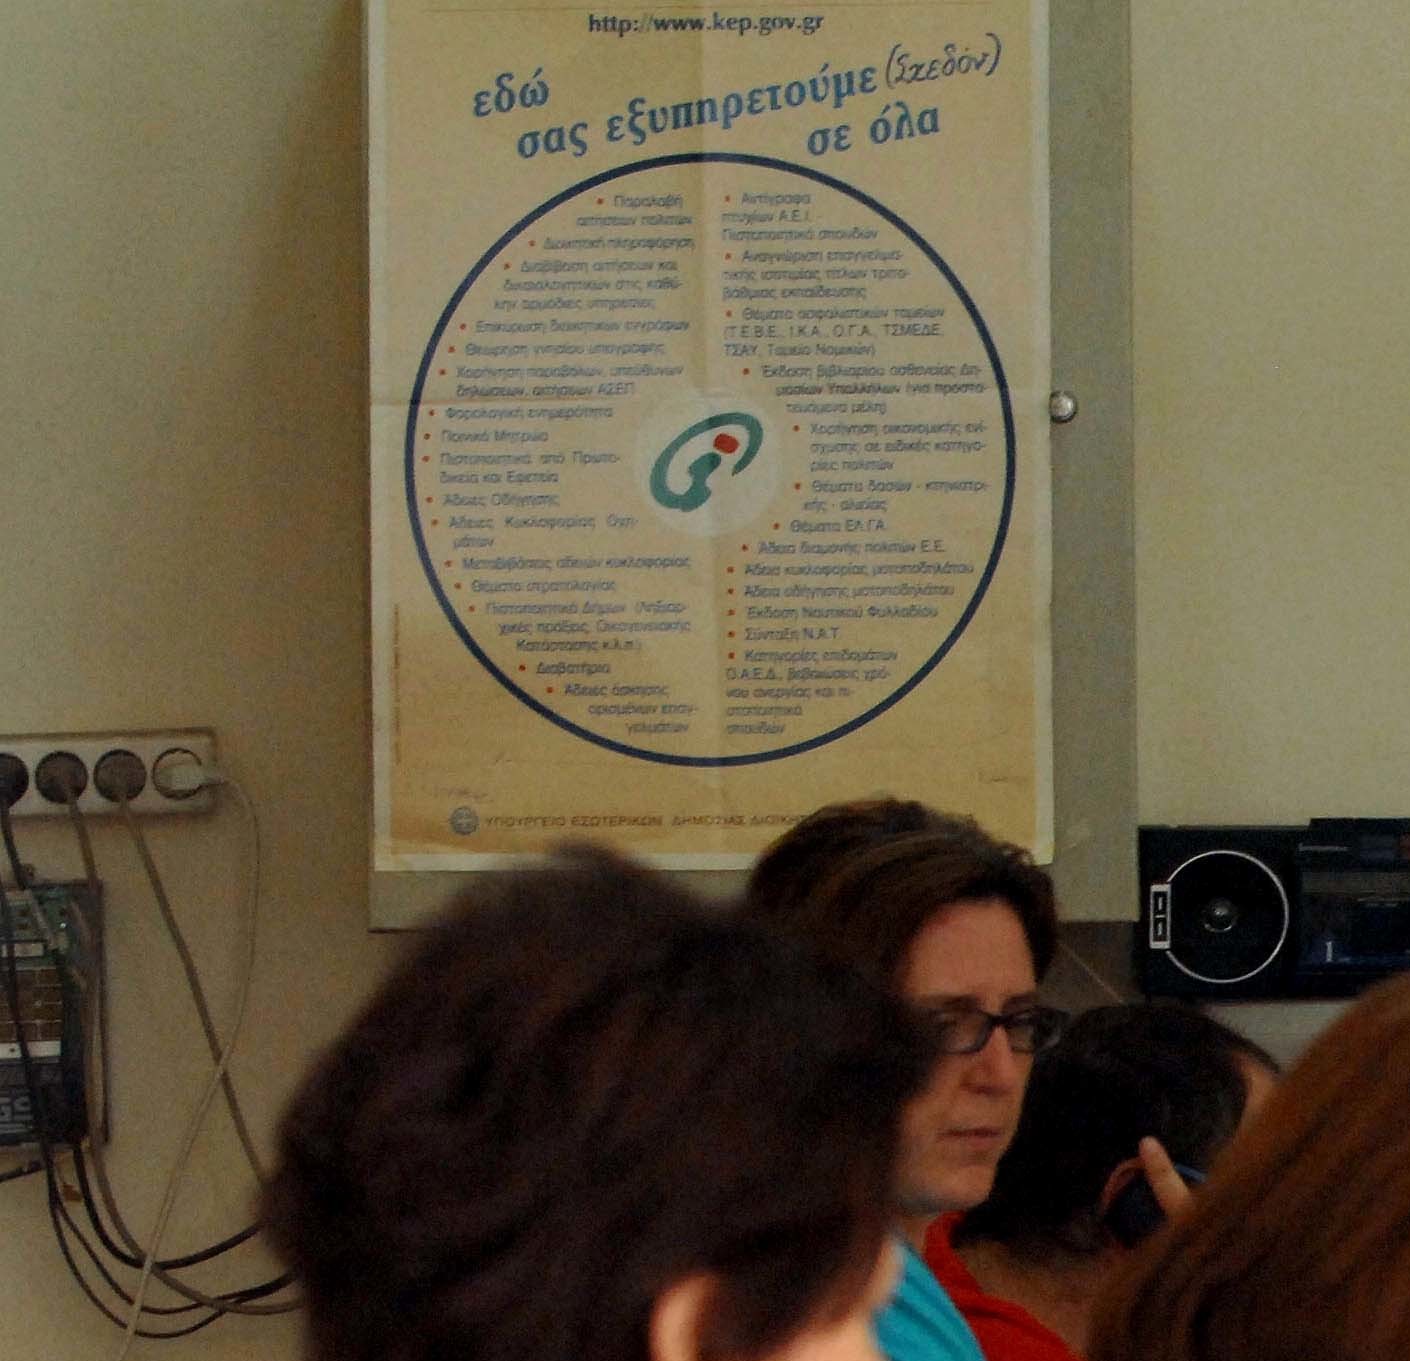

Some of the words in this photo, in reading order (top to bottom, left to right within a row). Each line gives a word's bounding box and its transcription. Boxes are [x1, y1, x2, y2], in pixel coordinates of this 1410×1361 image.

[588, 12, 825, 37] http://www.kep.gov.gr
[473, 68, 550, 119] εδώ
[517, 120, 588, 161] σας
[605, 63, 879, 146] εξυπηρετούμε
[807, 120, 853, 157] σε
[869, 103, 941, 145] όλα
